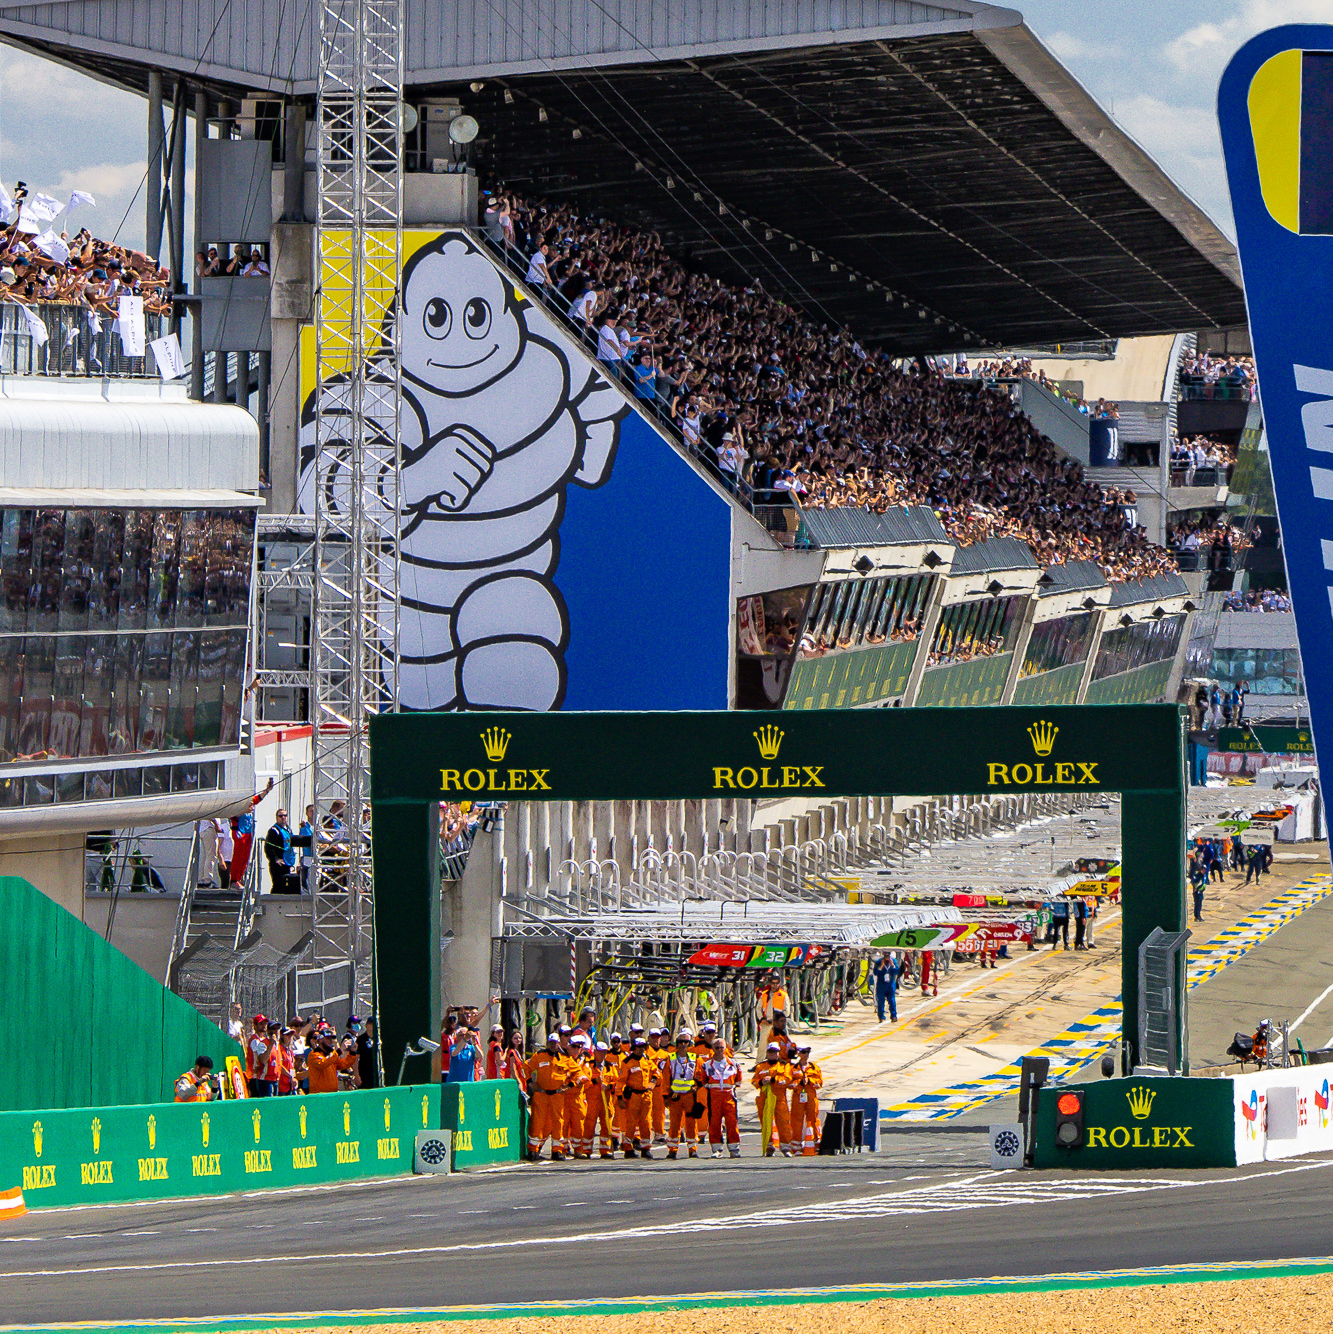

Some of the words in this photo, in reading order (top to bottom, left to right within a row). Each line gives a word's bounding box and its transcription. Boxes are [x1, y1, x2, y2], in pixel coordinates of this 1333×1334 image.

[1286, 742, 1314, 751] ROLE
[440, 769, 552, 791] ROLEX
[713, 766, 826, 789] ROLEX
[986, 762, 1100, 785] ROLEX
[1101, 882, 1108, 895] 5
[967, 895, 985, 905] 709
[1013, 928, 1024, 941] 9
[957, 939, 974, 952] 55
[731, 950, 746, 961] 31
[765, 951, 784, 962] 32
[1086, 1126, 1196, 1149] ROLEX
[22, 1165, 56, 1190] ROLEX
[81, 1161, 113, 1185] ROLEX
[138, 1157, 170, 1181] ROLEX
[192, 1153, 221, 1177] ROLEX
[244, 1150, 272, 1173] ROLEX
[292, 1145, 317, 1170] ROLEX
[336, 1141, 360, 1165] ROLEX
[376, 1138, 400, 1161] ROLEX
[487, 1127, 508, 1150] ROLEX
